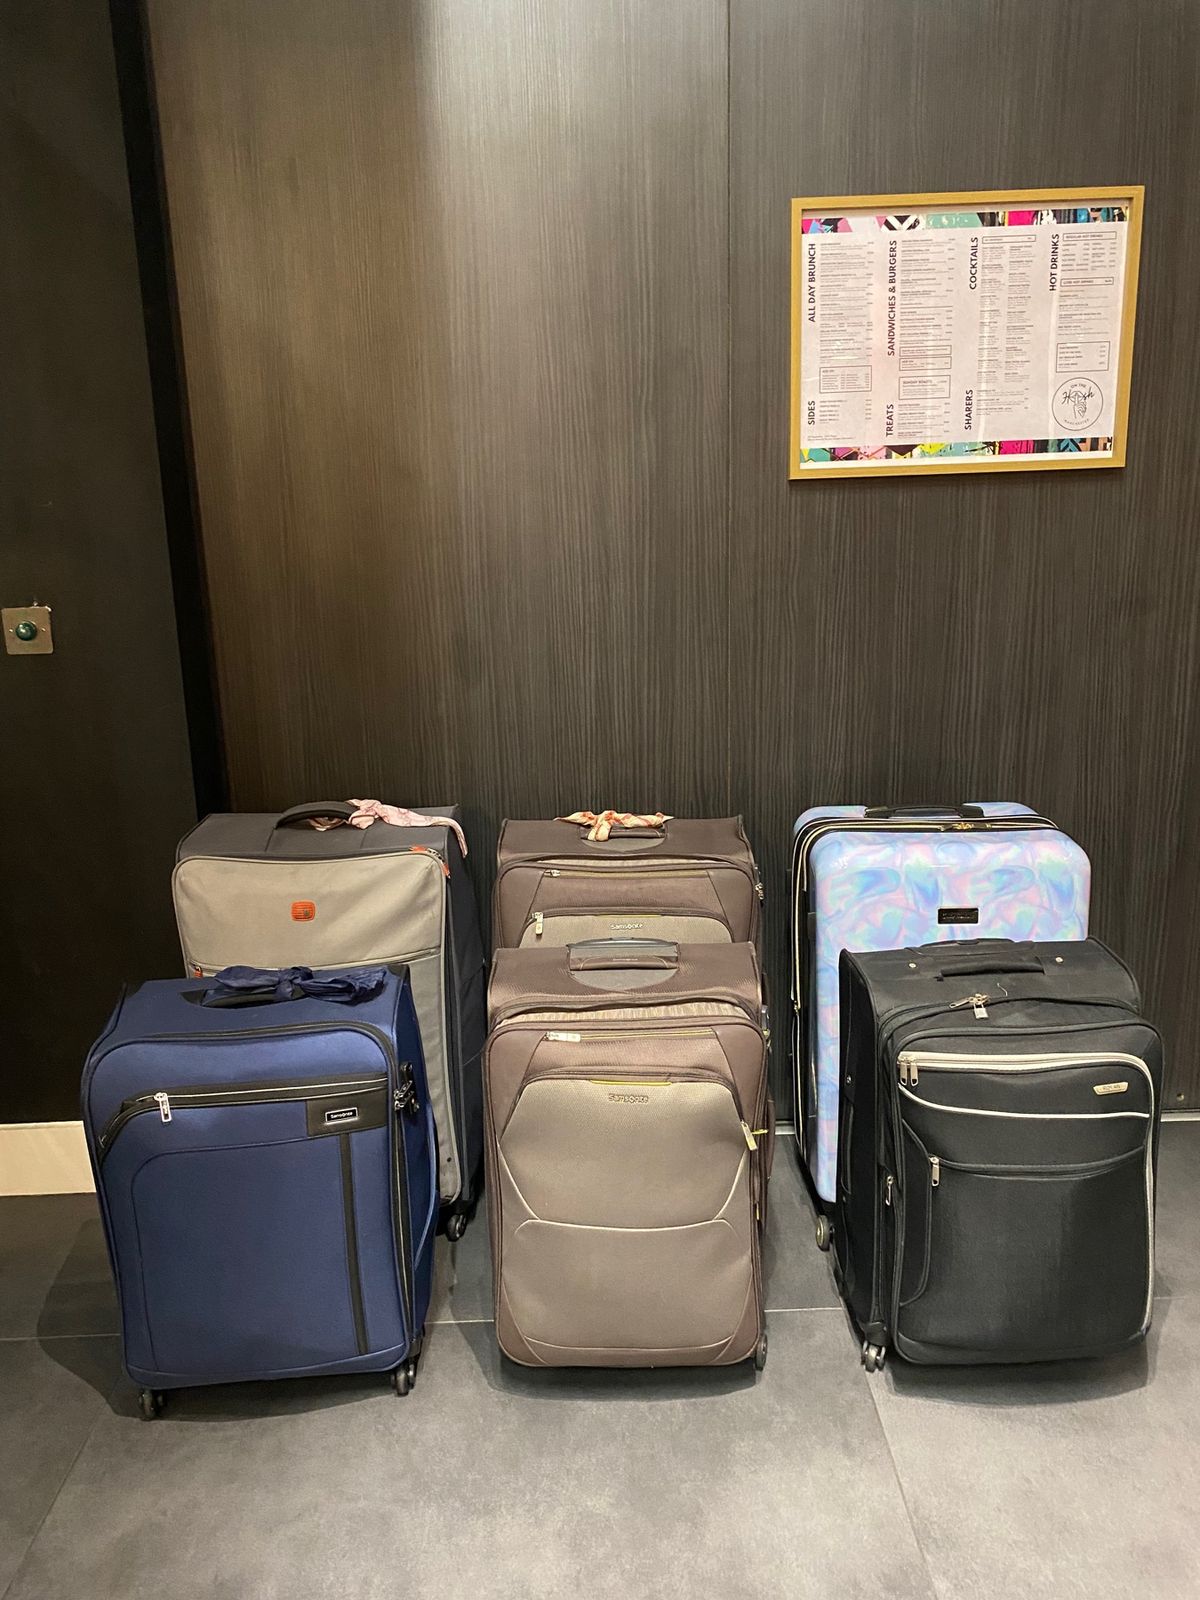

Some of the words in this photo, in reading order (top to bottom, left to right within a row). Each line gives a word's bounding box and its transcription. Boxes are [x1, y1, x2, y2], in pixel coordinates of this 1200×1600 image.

[808, 243, 816, 283] BRUNCH
[889, 240, 897, 284] BURGERS
[969, 237, 979, 290] COCKTAILS
[1050, 233, 1060, 270] DRINKS
[808, 285, 816, 304] DAY
[888, 285, 896, 293] &
[1049, 272, 1058, 291] HOT
[808, 306, 816, 323] ALL
[887, 295, 896, 356] SANDWICHES
[807, 400, 816, 425] SIDES
[886, 403, 894, 437] TREATS
[964, 389, 973, 430] SHARERS
